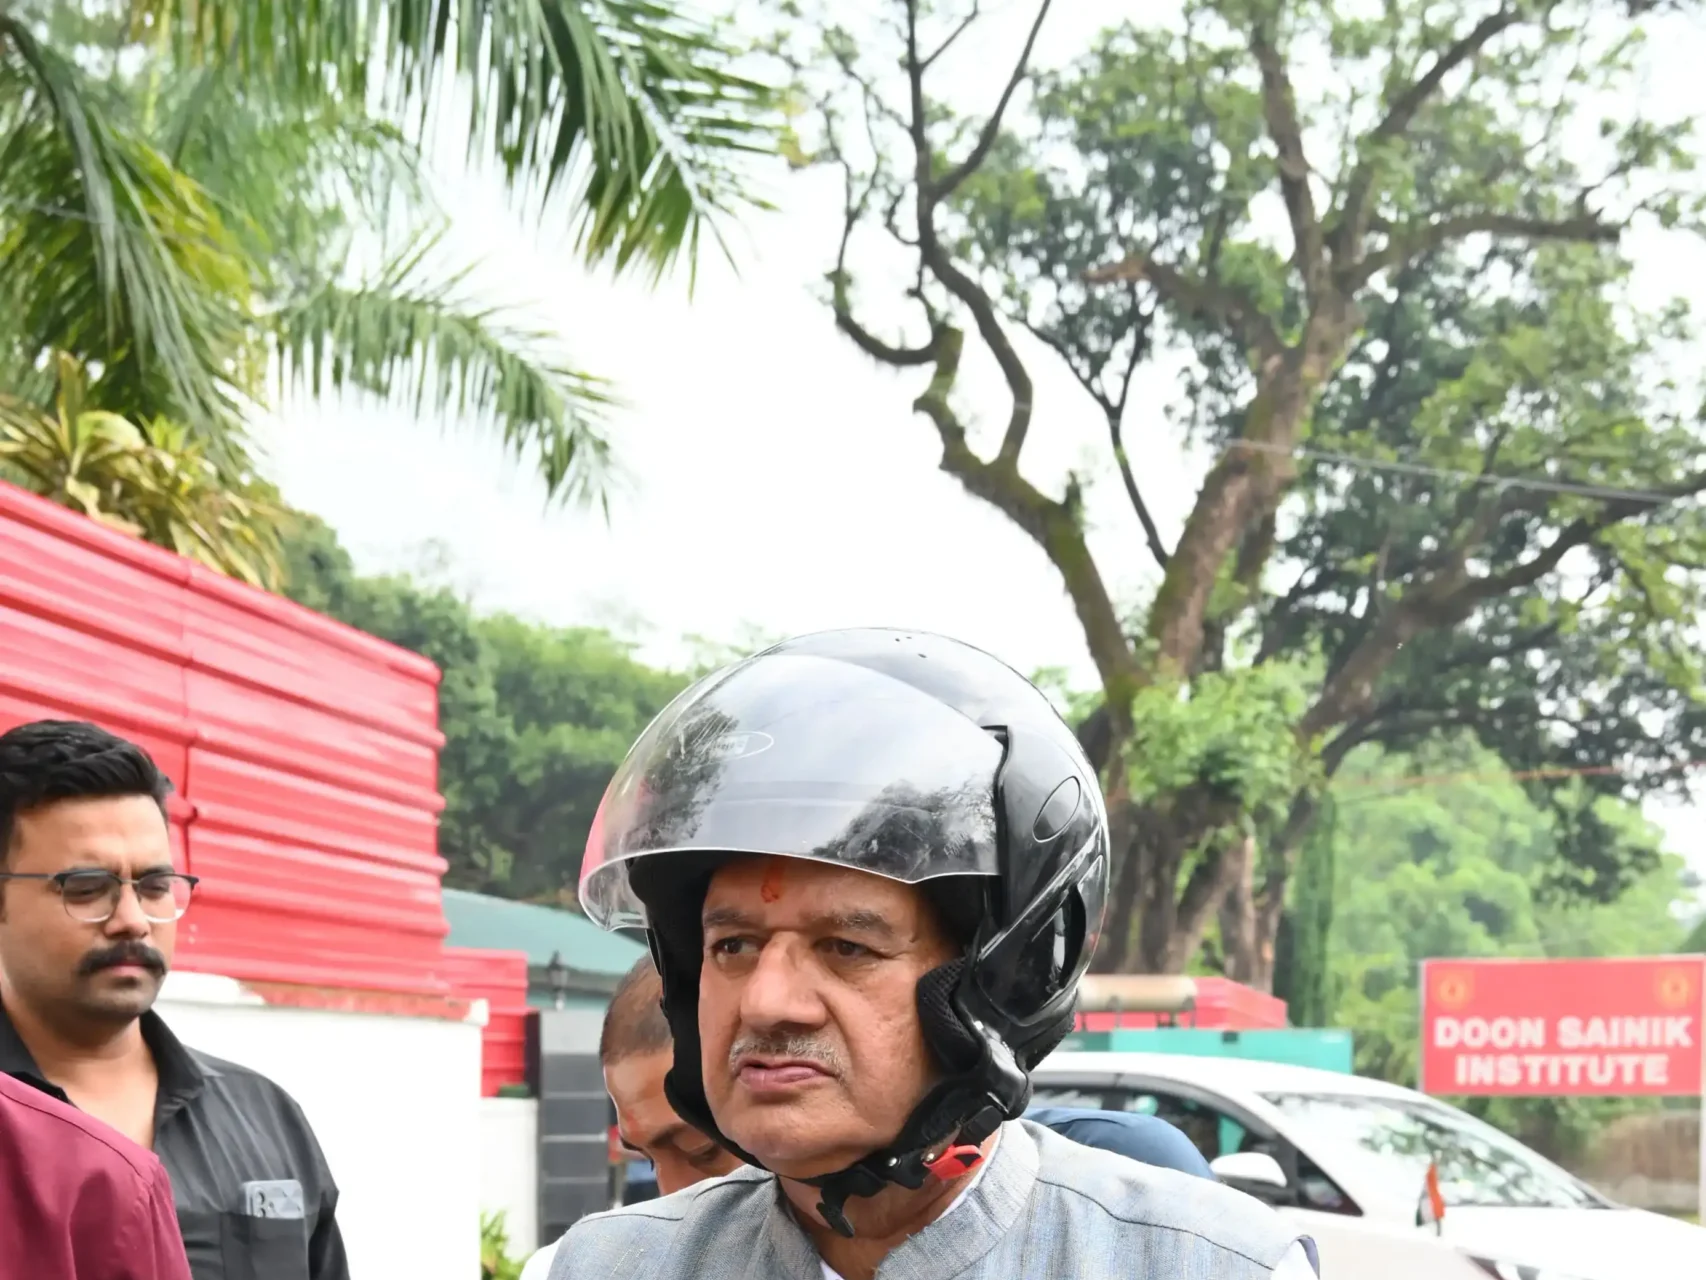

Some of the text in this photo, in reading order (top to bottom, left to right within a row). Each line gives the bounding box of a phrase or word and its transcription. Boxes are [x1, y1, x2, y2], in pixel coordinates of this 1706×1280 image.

[1434, 1015, 1693, 1048] DOON SAINIK
[1455, 1053, 1669, 1086] INSTITUTE
